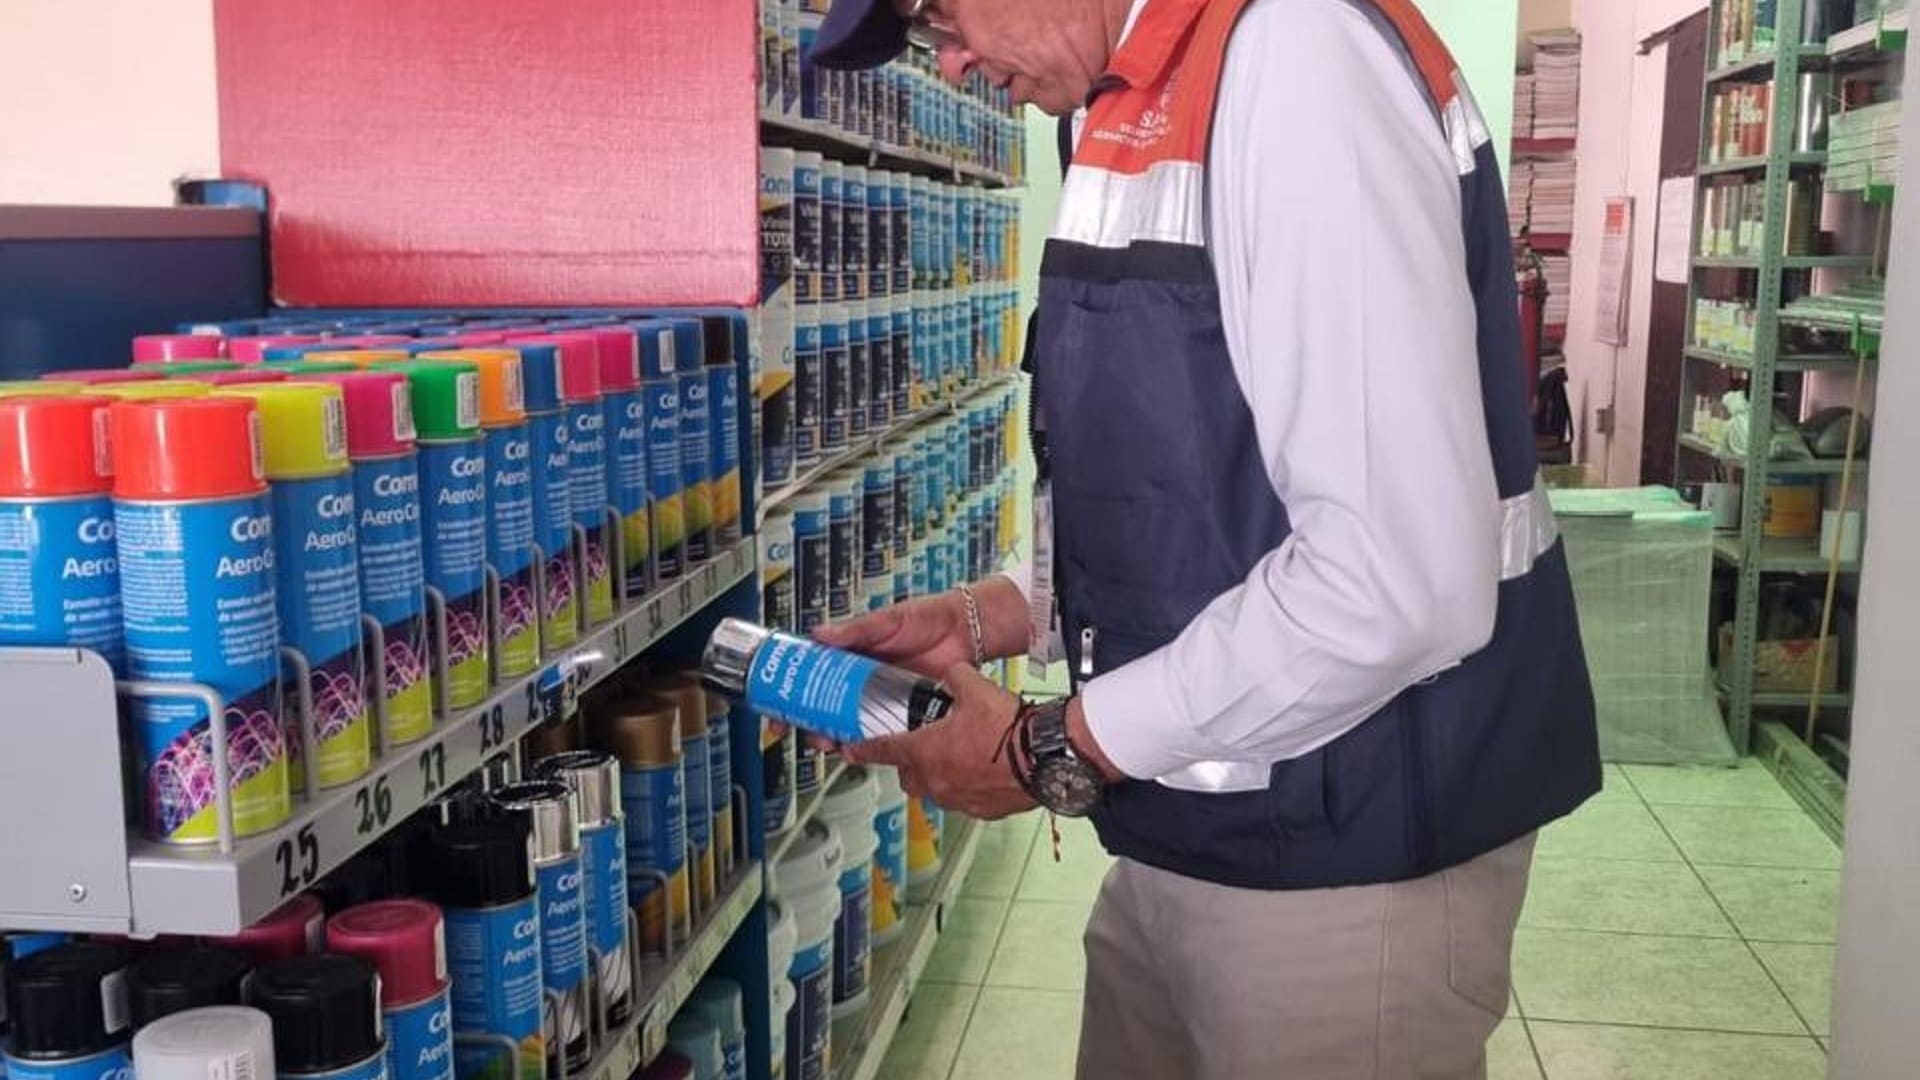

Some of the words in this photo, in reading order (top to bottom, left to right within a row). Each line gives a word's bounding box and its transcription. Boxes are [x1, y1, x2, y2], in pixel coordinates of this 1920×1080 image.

[479, 703, 504, 754] 28
[419, 741, 447, 797] 27
[354, 773, 392, 835] 26
[276, 822, 319, 897] 25
